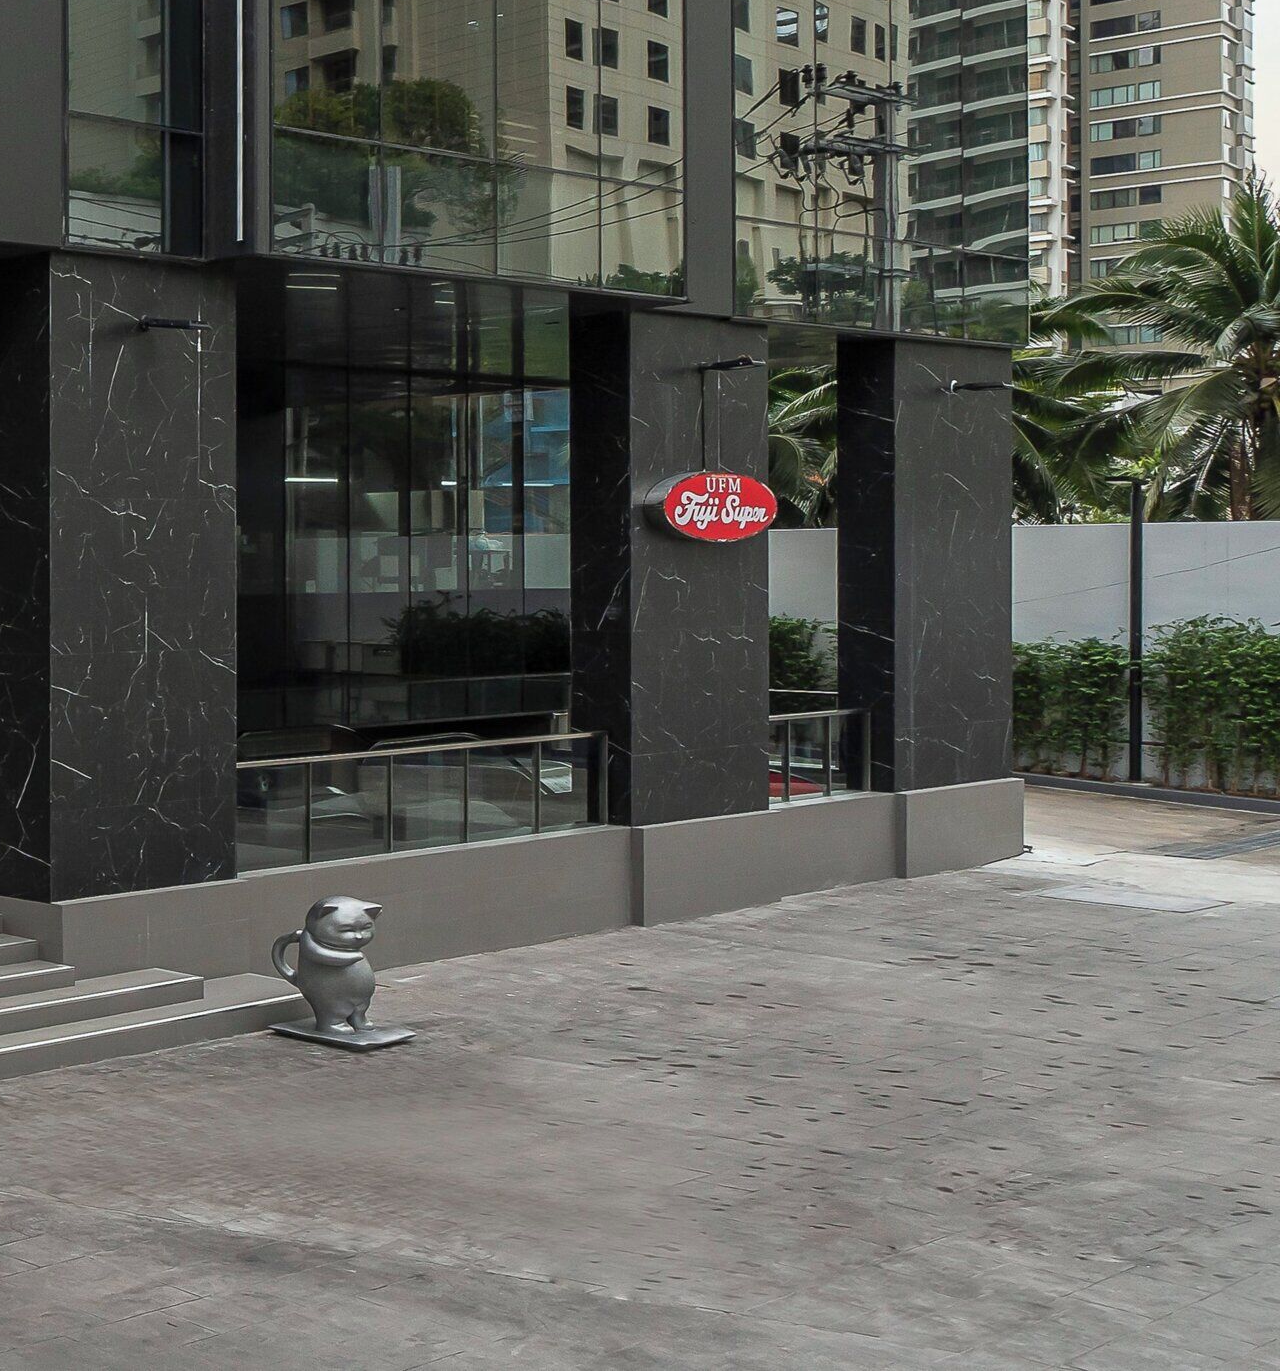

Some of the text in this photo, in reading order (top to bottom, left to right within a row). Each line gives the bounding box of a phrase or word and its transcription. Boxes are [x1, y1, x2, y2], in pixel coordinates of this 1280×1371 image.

[706, 477, 741, 493] UFM
[674, 491, 769, 530] Fuji Super
